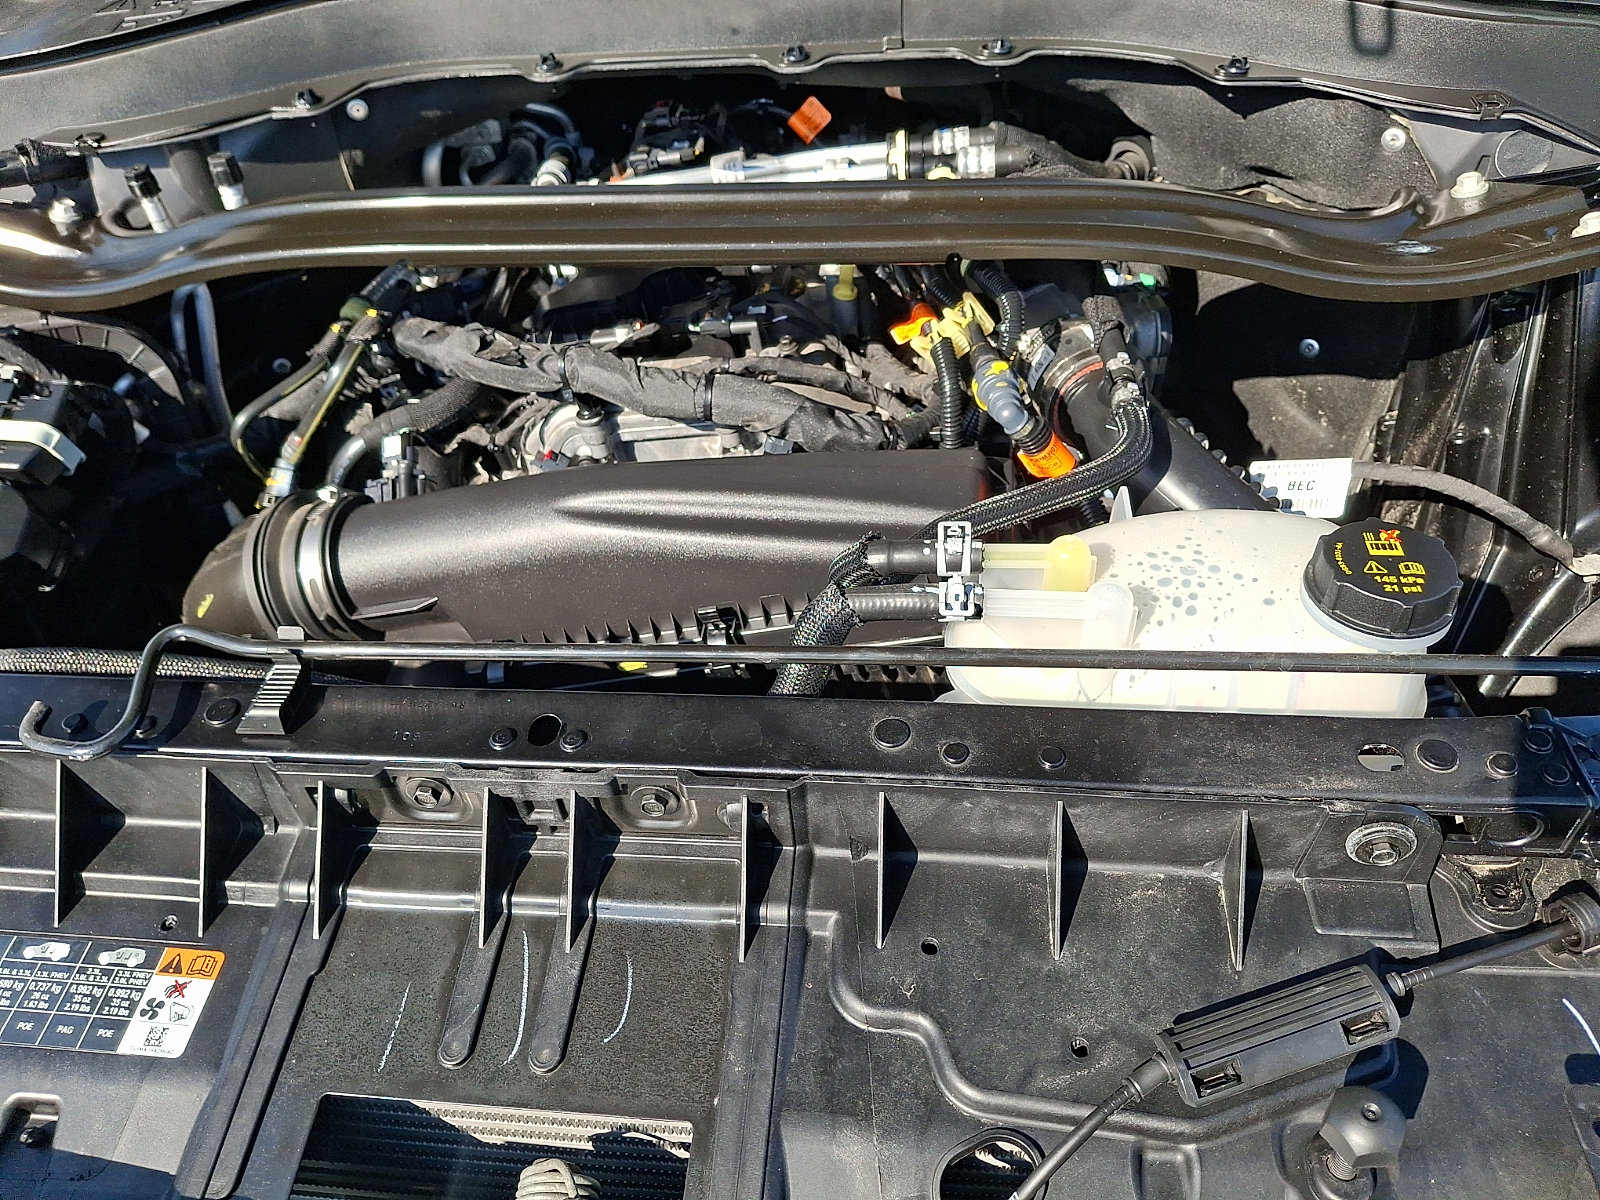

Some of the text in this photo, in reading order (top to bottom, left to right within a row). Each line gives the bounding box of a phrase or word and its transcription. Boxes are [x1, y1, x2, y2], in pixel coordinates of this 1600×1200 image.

[1287, 480, 1315, 491] BEC
[1374, 575, 1426, 584] 145 kPa
[1383, 584, 1422, 594] 21 psi
[12, 980, 25, 992] kg
[29, 981, 63, 995] 0.737 kg
[70, 984, 104, 998] 0.992 kg
[31, 991, 42, 999] 26
[72, 995, 92, 1004] 35 oz
[107, 987, 142, 1002] 0.992 kg
[37, 1000, 50, 1009] lbs
[63, 1002, 91, 1012] 2.19 lbs
[110, 998, 131, 1008] 35 oz
[102, 1006, 130, 1016] 2.19 lbs
[16, 1021, 35, 1031] POE
[56, 1024, 75, 1035] PAG
[96, 1028, 115, 1038] POE
